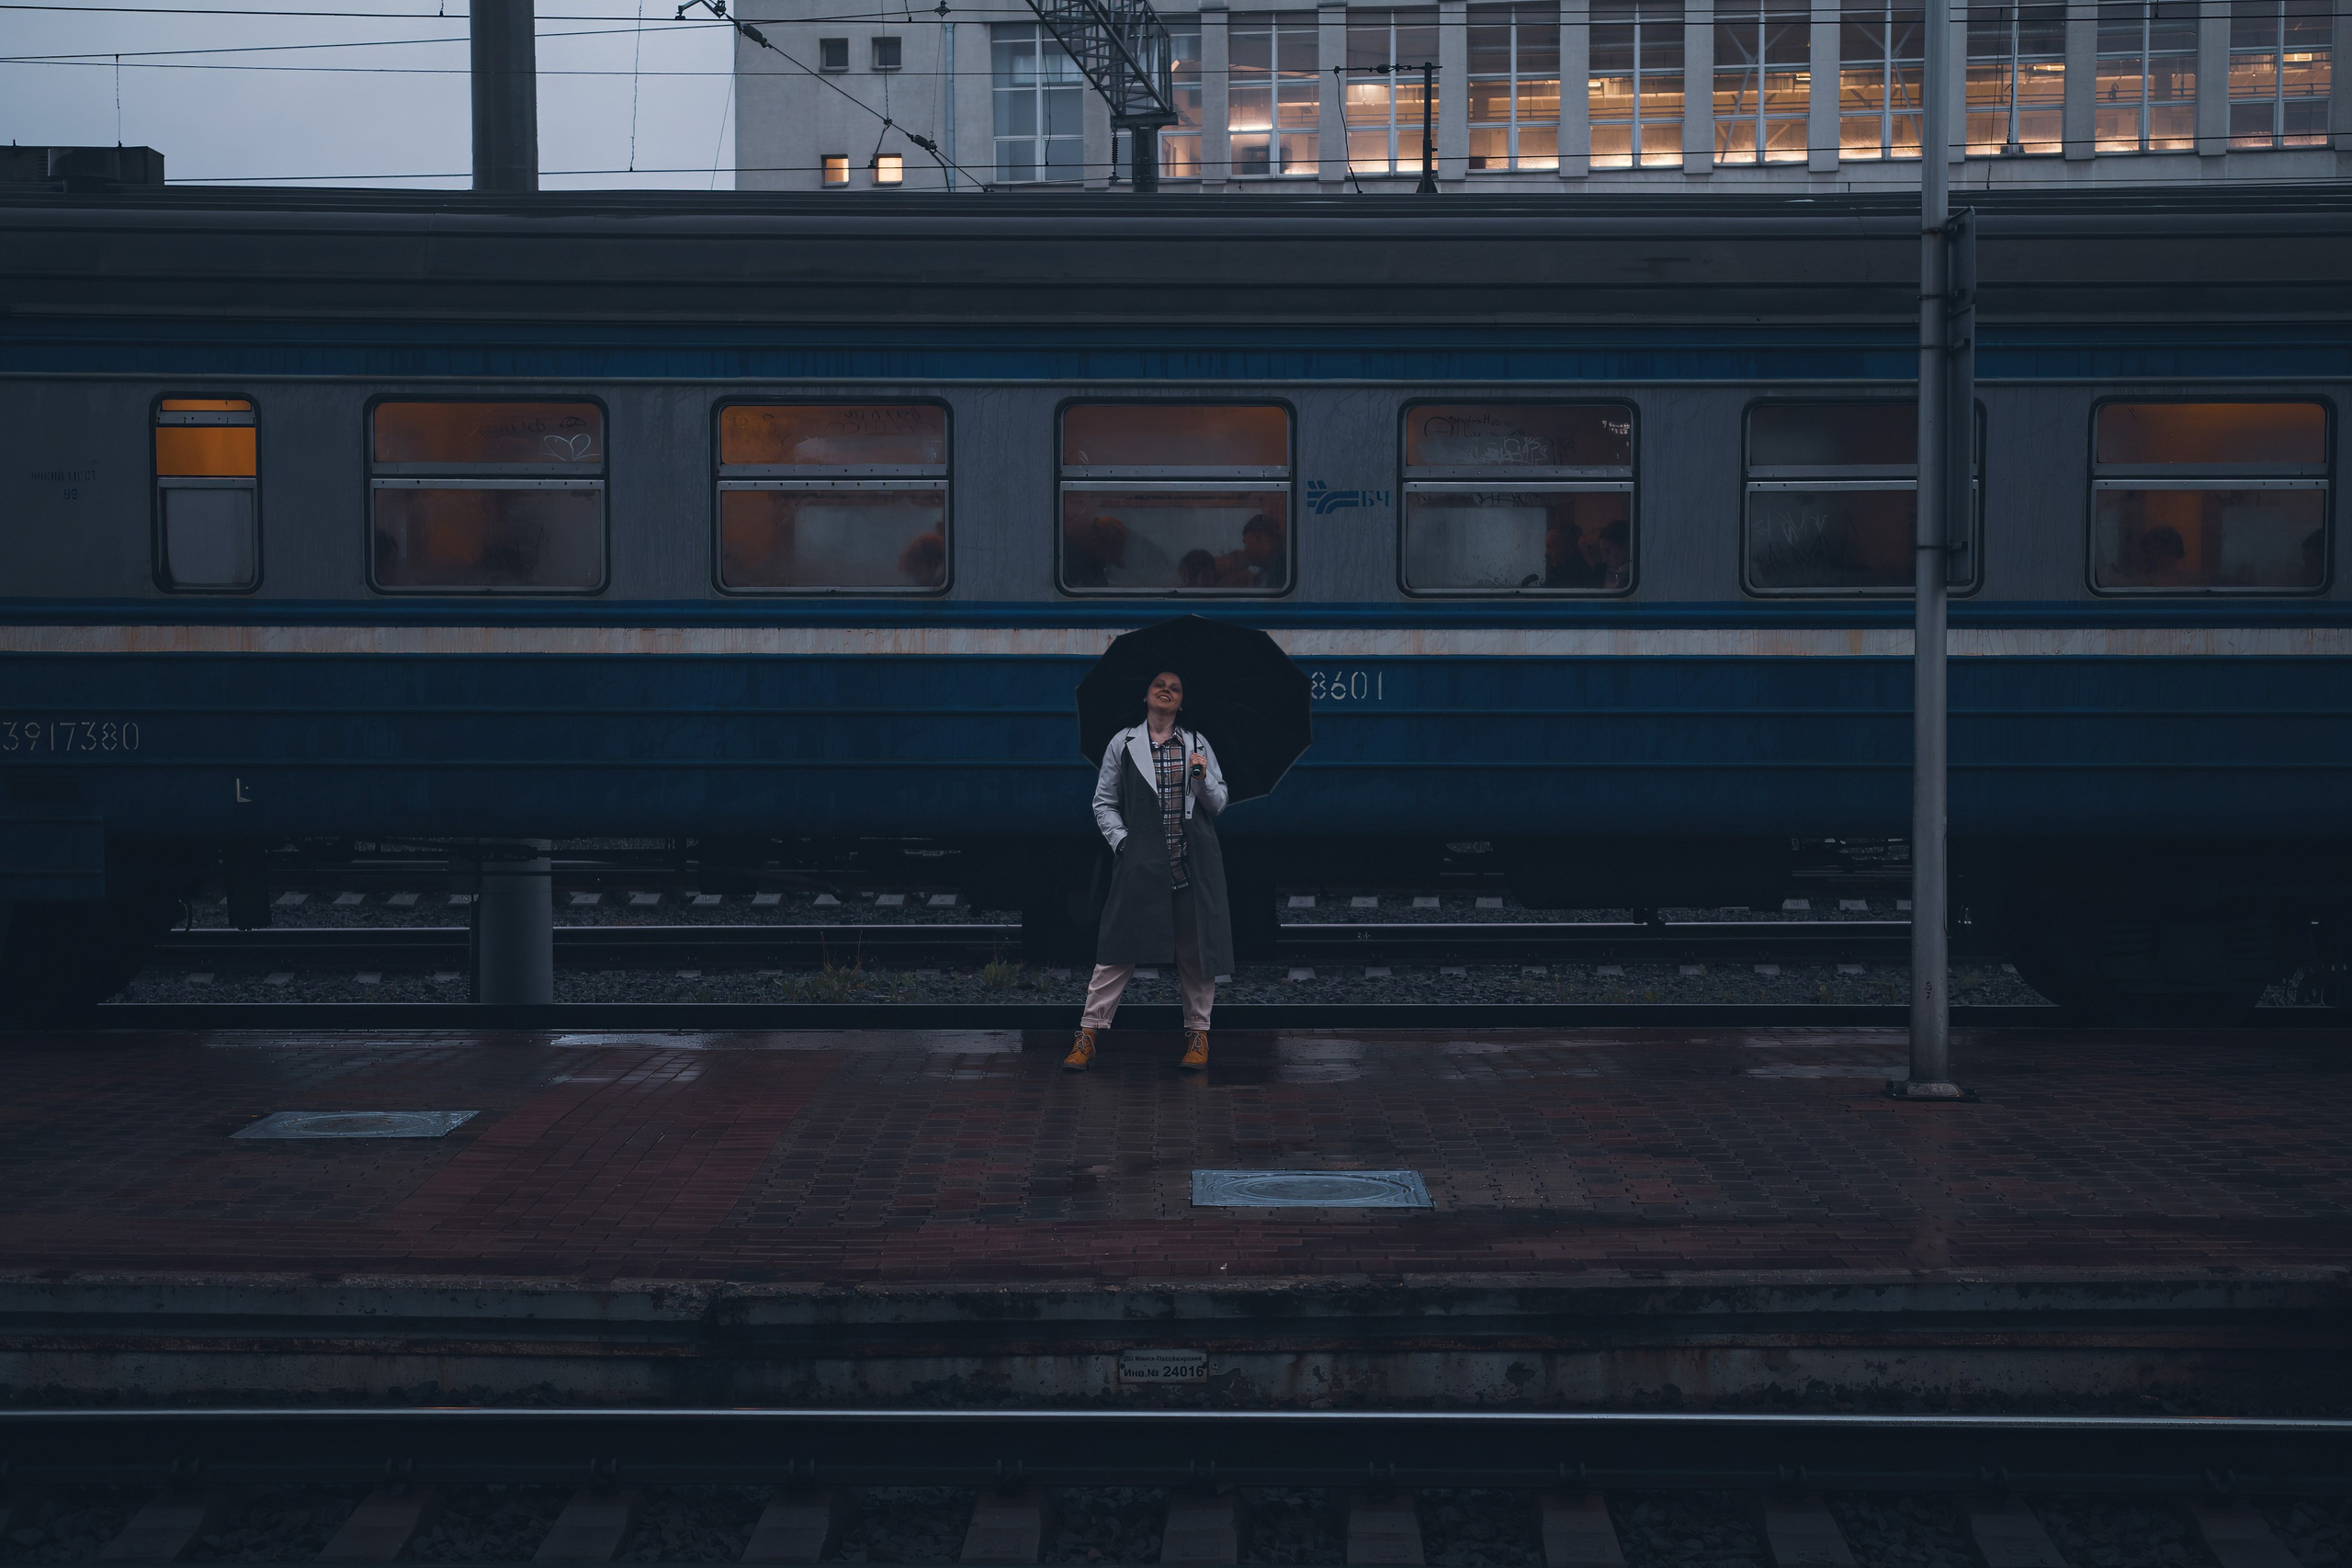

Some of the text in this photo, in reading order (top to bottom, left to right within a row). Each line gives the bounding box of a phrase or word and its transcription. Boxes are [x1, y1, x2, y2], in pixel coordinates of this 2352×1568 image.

[1362, 490, 1390, 507] БЧ
[1310, 671, 1383, 700] 8601
[3, 721, 140, 751] 3917380
[1163, 1365, 1204, 1378] 24016
